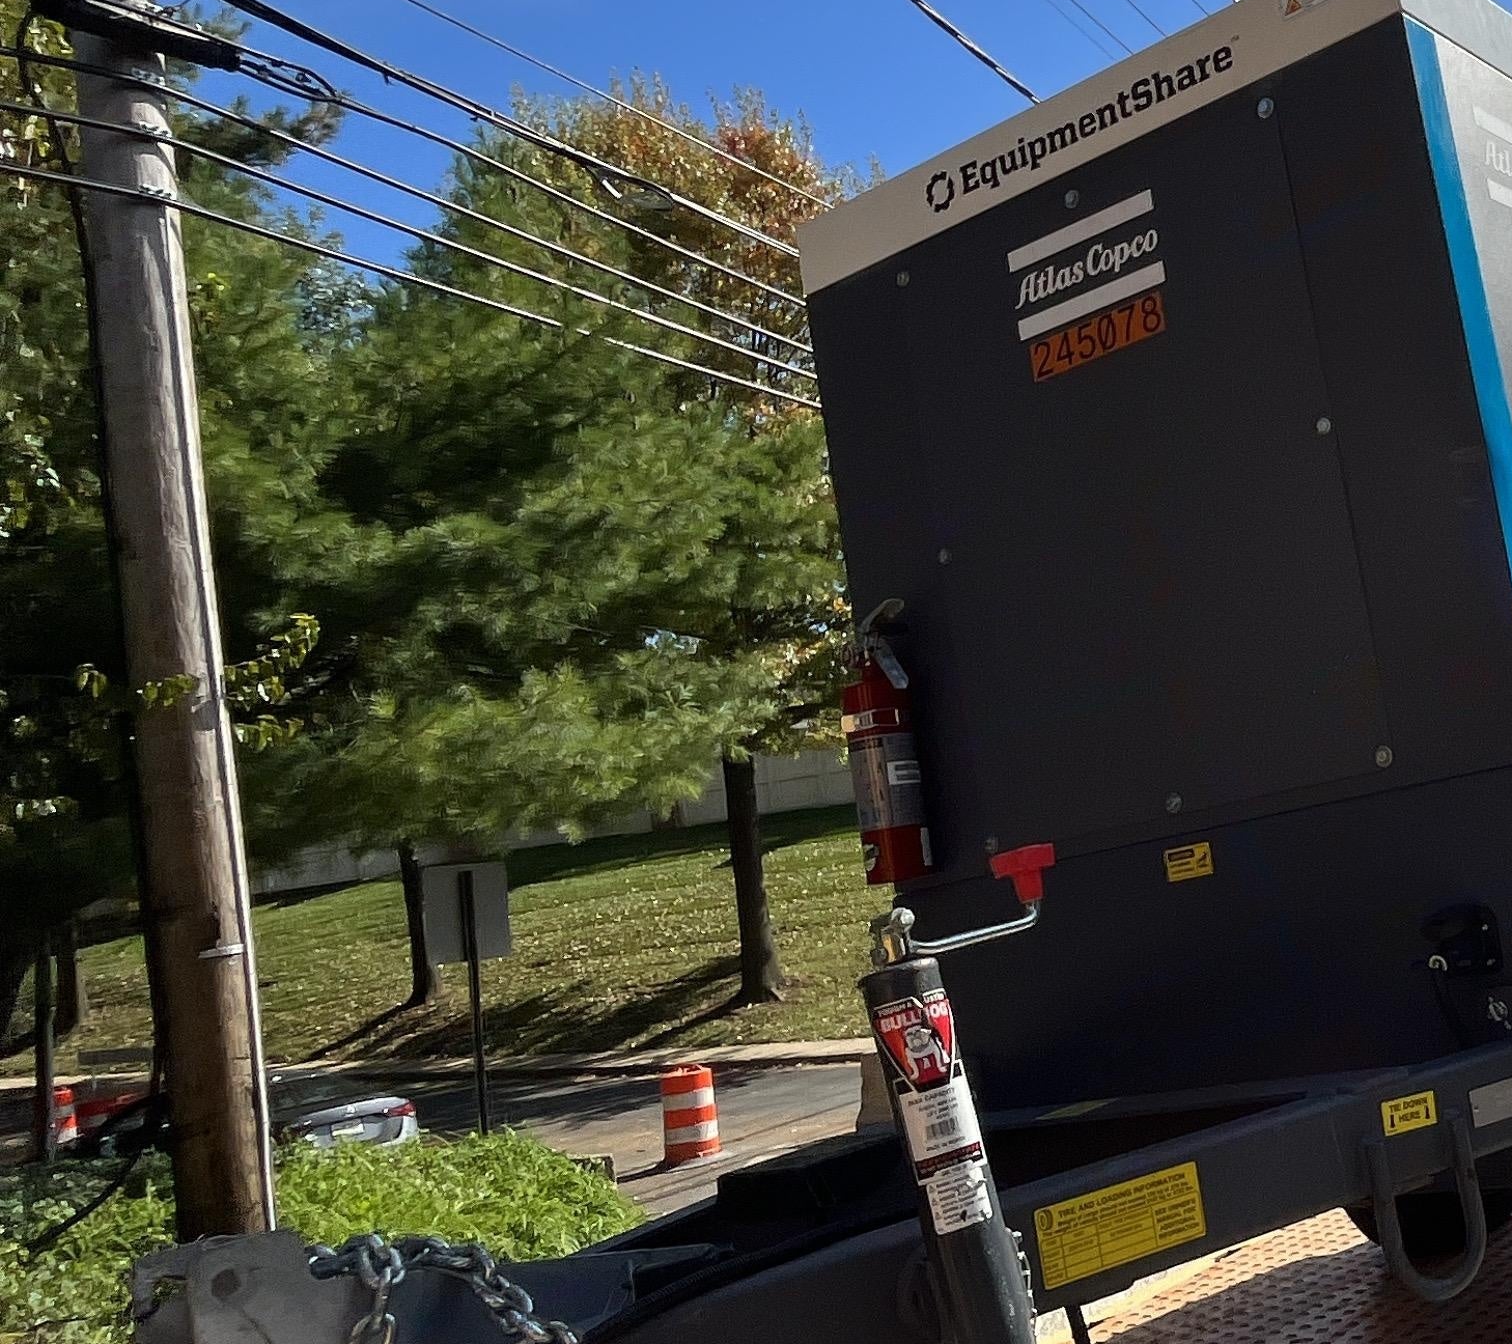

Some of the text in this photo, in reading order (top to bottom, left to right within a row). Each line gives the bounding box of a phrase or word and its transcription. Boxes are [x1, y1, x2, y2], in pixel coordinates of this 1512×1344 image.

[959, 44, 1234, 196] EquipmentShare
[1015, 229, 1159, 310] Atlas Copco
[1034, 295, 1162, 379] 245078
[1389, 1096, 1428, 1114] TIE DOWN
[1399, 1110, 1422, 1124] HERE
[1057, 1172, 1185, 1218] TIRE AND LOADING INFORMATION
